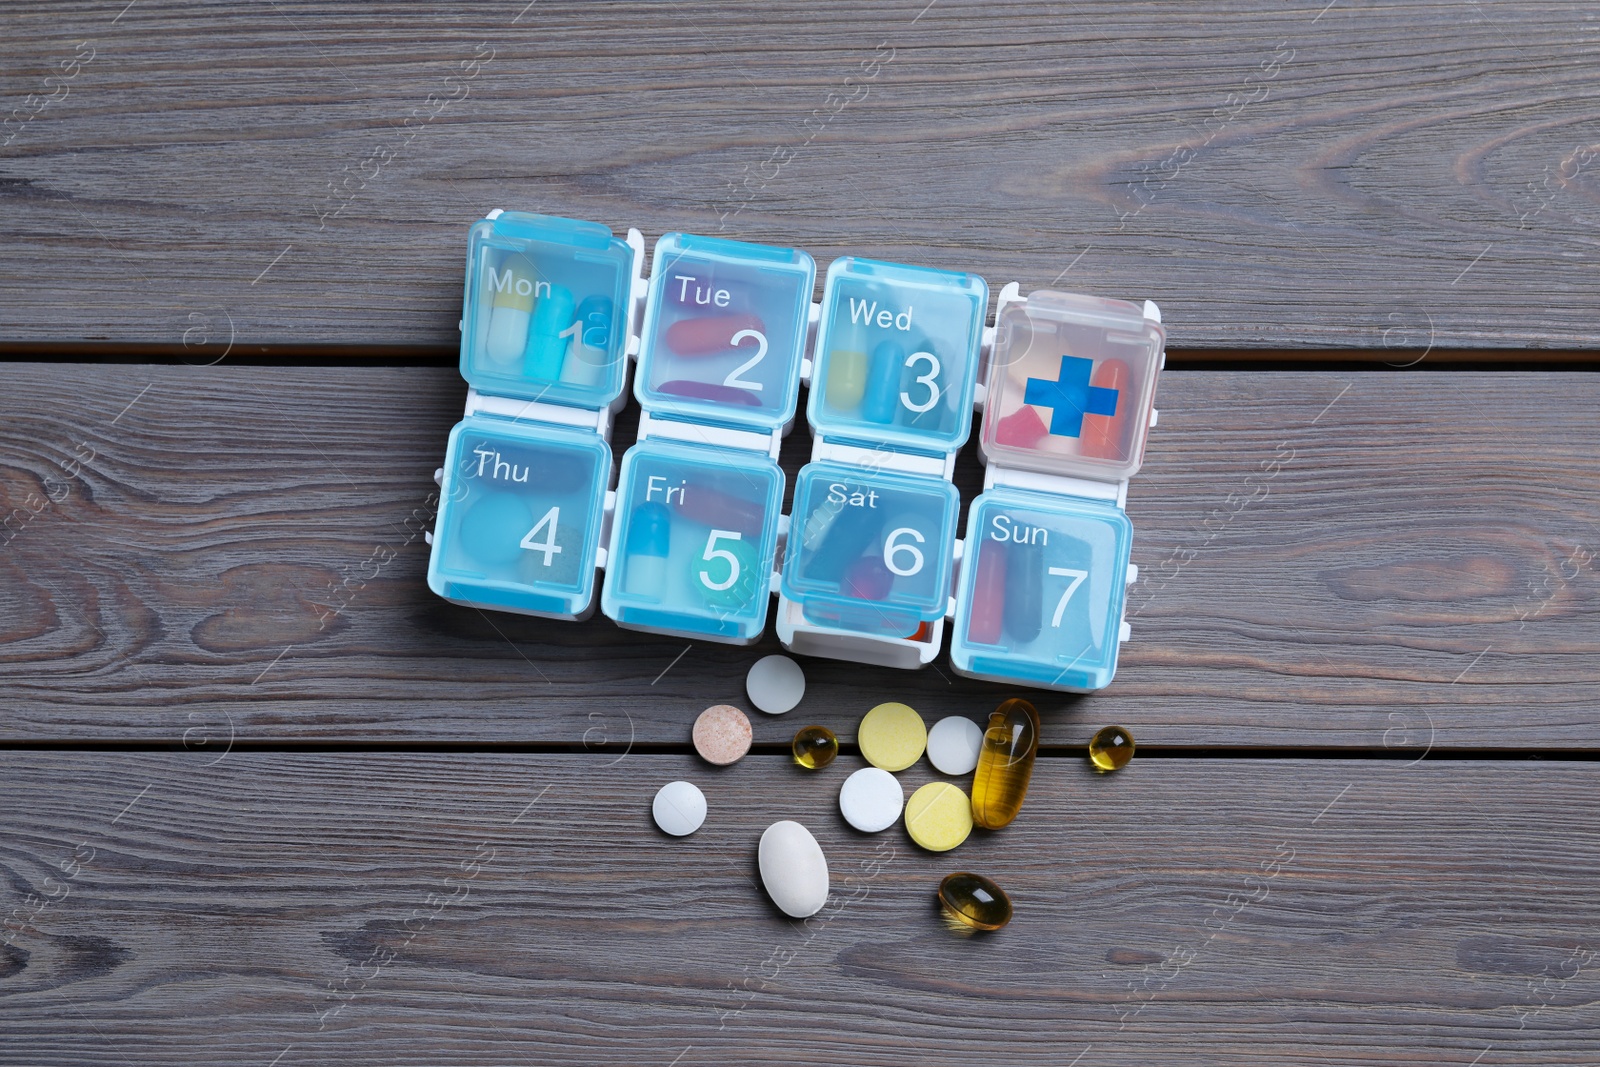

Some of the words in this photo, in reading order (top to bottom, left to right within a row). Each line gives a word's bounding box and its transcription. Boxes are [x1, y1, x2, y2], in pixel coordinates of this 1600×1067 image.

[487, 267, 551, 299] Mon
[675, 275, 731, 308] Tue
[850, 297, 912, 331] Wed
[723, 329, 769, 391] 2
[900, 352, 941, 413] 3
[472, 450, 529, 483] Thu
[647, 476, 685, 506] Fri
[828, 483, 879, 509] Sat
[519, 506, 562, 567] 4
[990, 515, 1048, 546] Sun
[699, 529, 742, 592] 5
[884, 528, 925, 577] 6
[1047, 567, 1088, 628] 7
